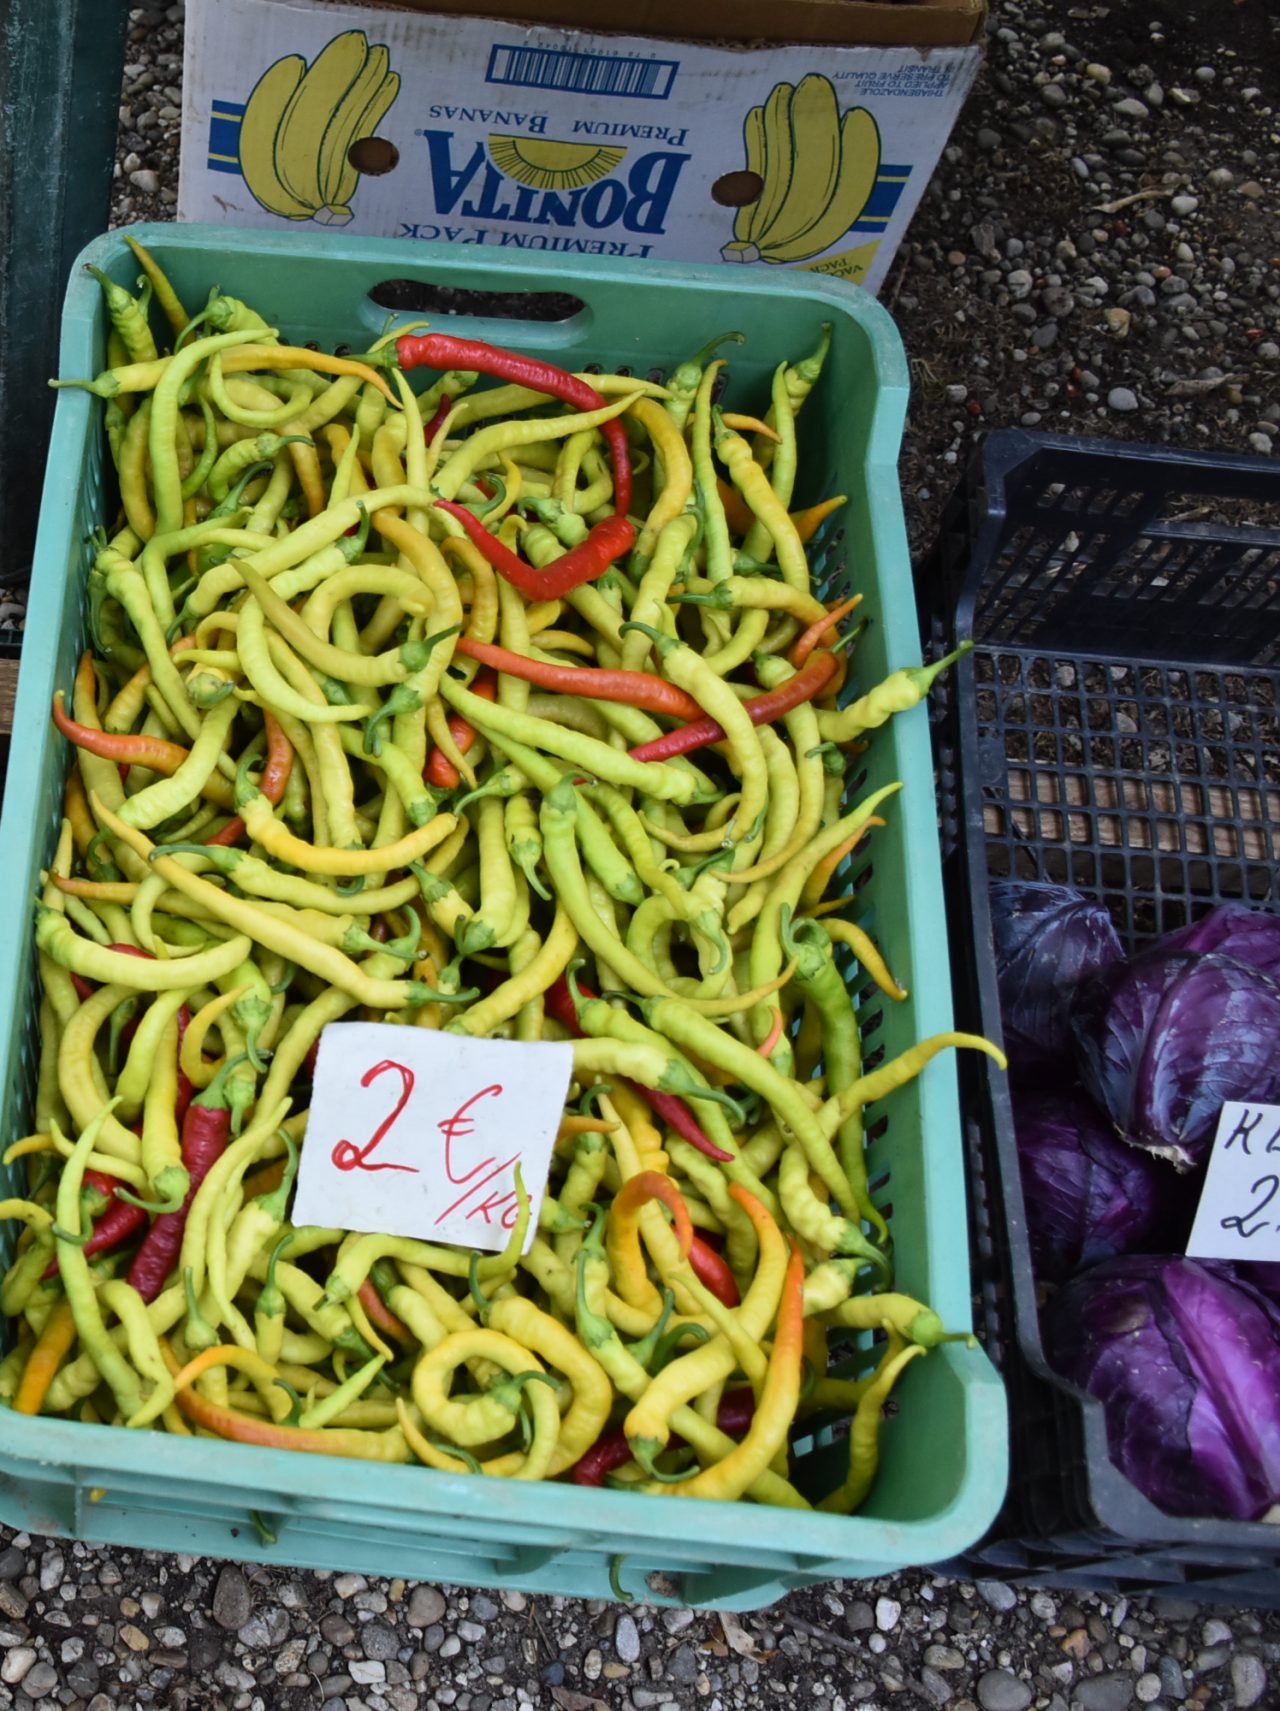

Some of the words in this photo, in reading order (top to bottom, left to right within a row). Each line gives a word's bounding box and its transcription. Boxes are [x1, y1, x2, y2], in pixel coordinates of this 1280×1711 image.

[832, 71, 877, 80] QUALITY
[854, 80, 886, 88] FRUIT
[887, 80, 902, 88] TO
[429, 105, 550, 135] BANANAS
[572, 120, 690, 147] PREMIUM
[423, 130, 692, 235] BONITA
[400, 223, 491, 245] PACK
[499, 231, 655, 259] PREMIUM
[331, 1060, 419, 1171] 2
